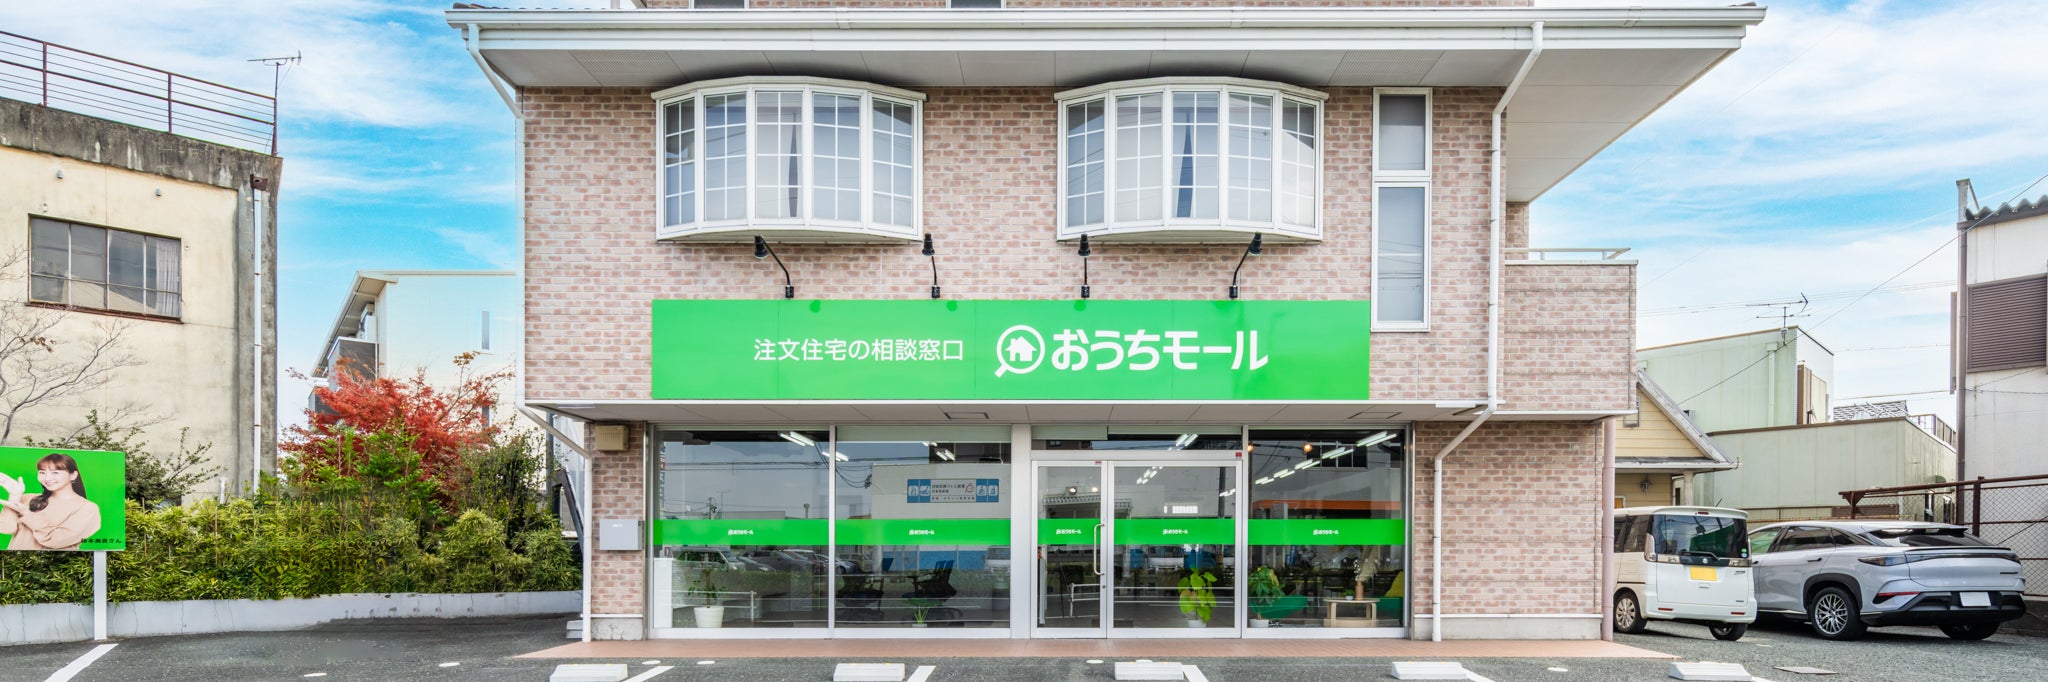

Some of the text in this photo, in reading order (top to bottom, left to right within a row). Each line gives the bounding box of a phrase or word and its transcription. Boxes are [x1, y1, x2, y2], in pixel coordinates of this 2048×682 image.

[753, 338, 963, 362] 注文住宅の相談窓口
[1051, 328, 1269, 371] おうちモール
